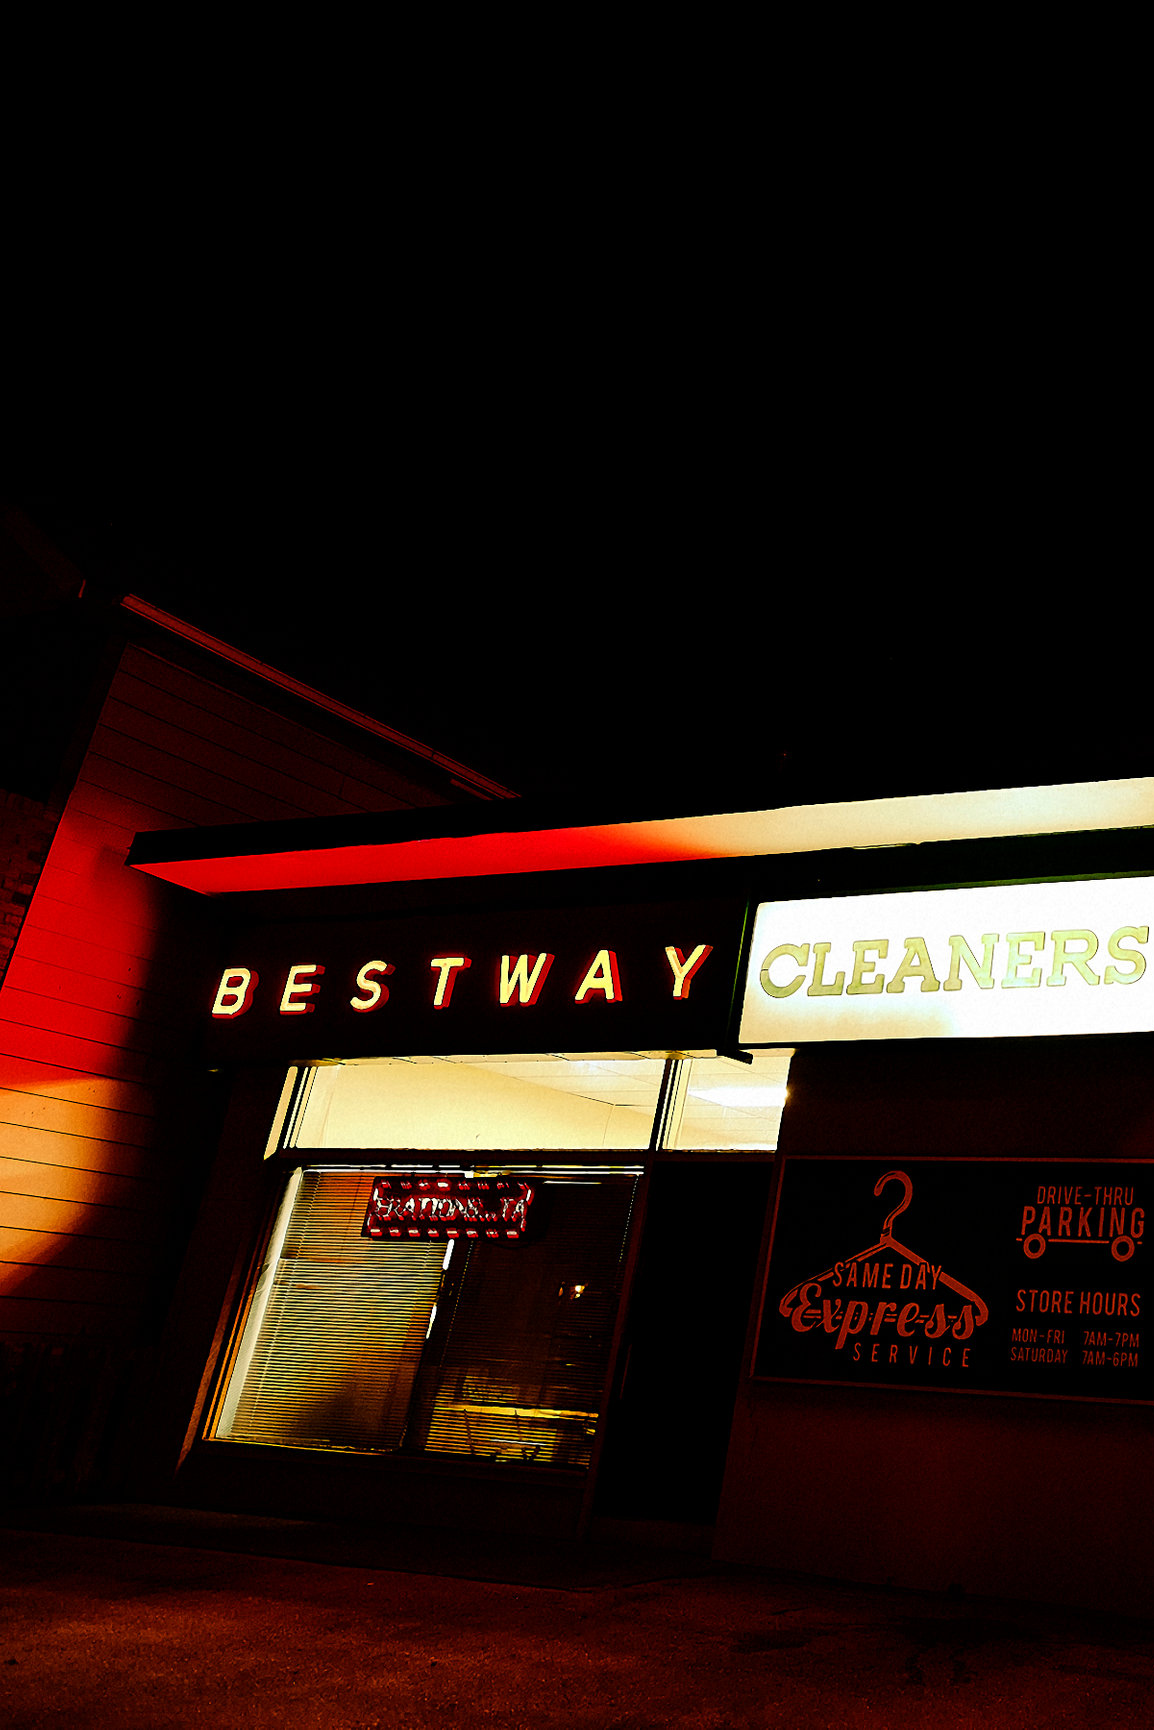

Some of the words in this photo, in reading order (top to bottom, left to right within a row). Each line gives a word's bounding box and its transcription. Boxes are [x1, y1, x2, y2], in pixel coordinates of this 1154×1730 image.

[759, 925, 1150, 998] CLEANERS
[211, 944, 713, 1019] BESTWAY
[1036, 1186, 1134, 1206] DRIVE-THRU
[1021, 1206, 1145, 1238] PARKING
[833, 1262, 892, 1289] SAME
[899, 1263, 942, 1290] DAY
[791, 1282, 977, 1349] Express
[1015, 1289, 1073, 1314] STORE
[1079, 1291, 1141, 1317] HOURS
[1011, 1327, 1065, 1344] MON-FRI
[1083, 1331, 1140, 1349] 7AM-7PM
[852, 1342, 971, 1368] SERVICE
[1010, 1347, 1068, 1364] SATURDAY
[1081, 1349, 1139, 1367] 7AM-6PM
